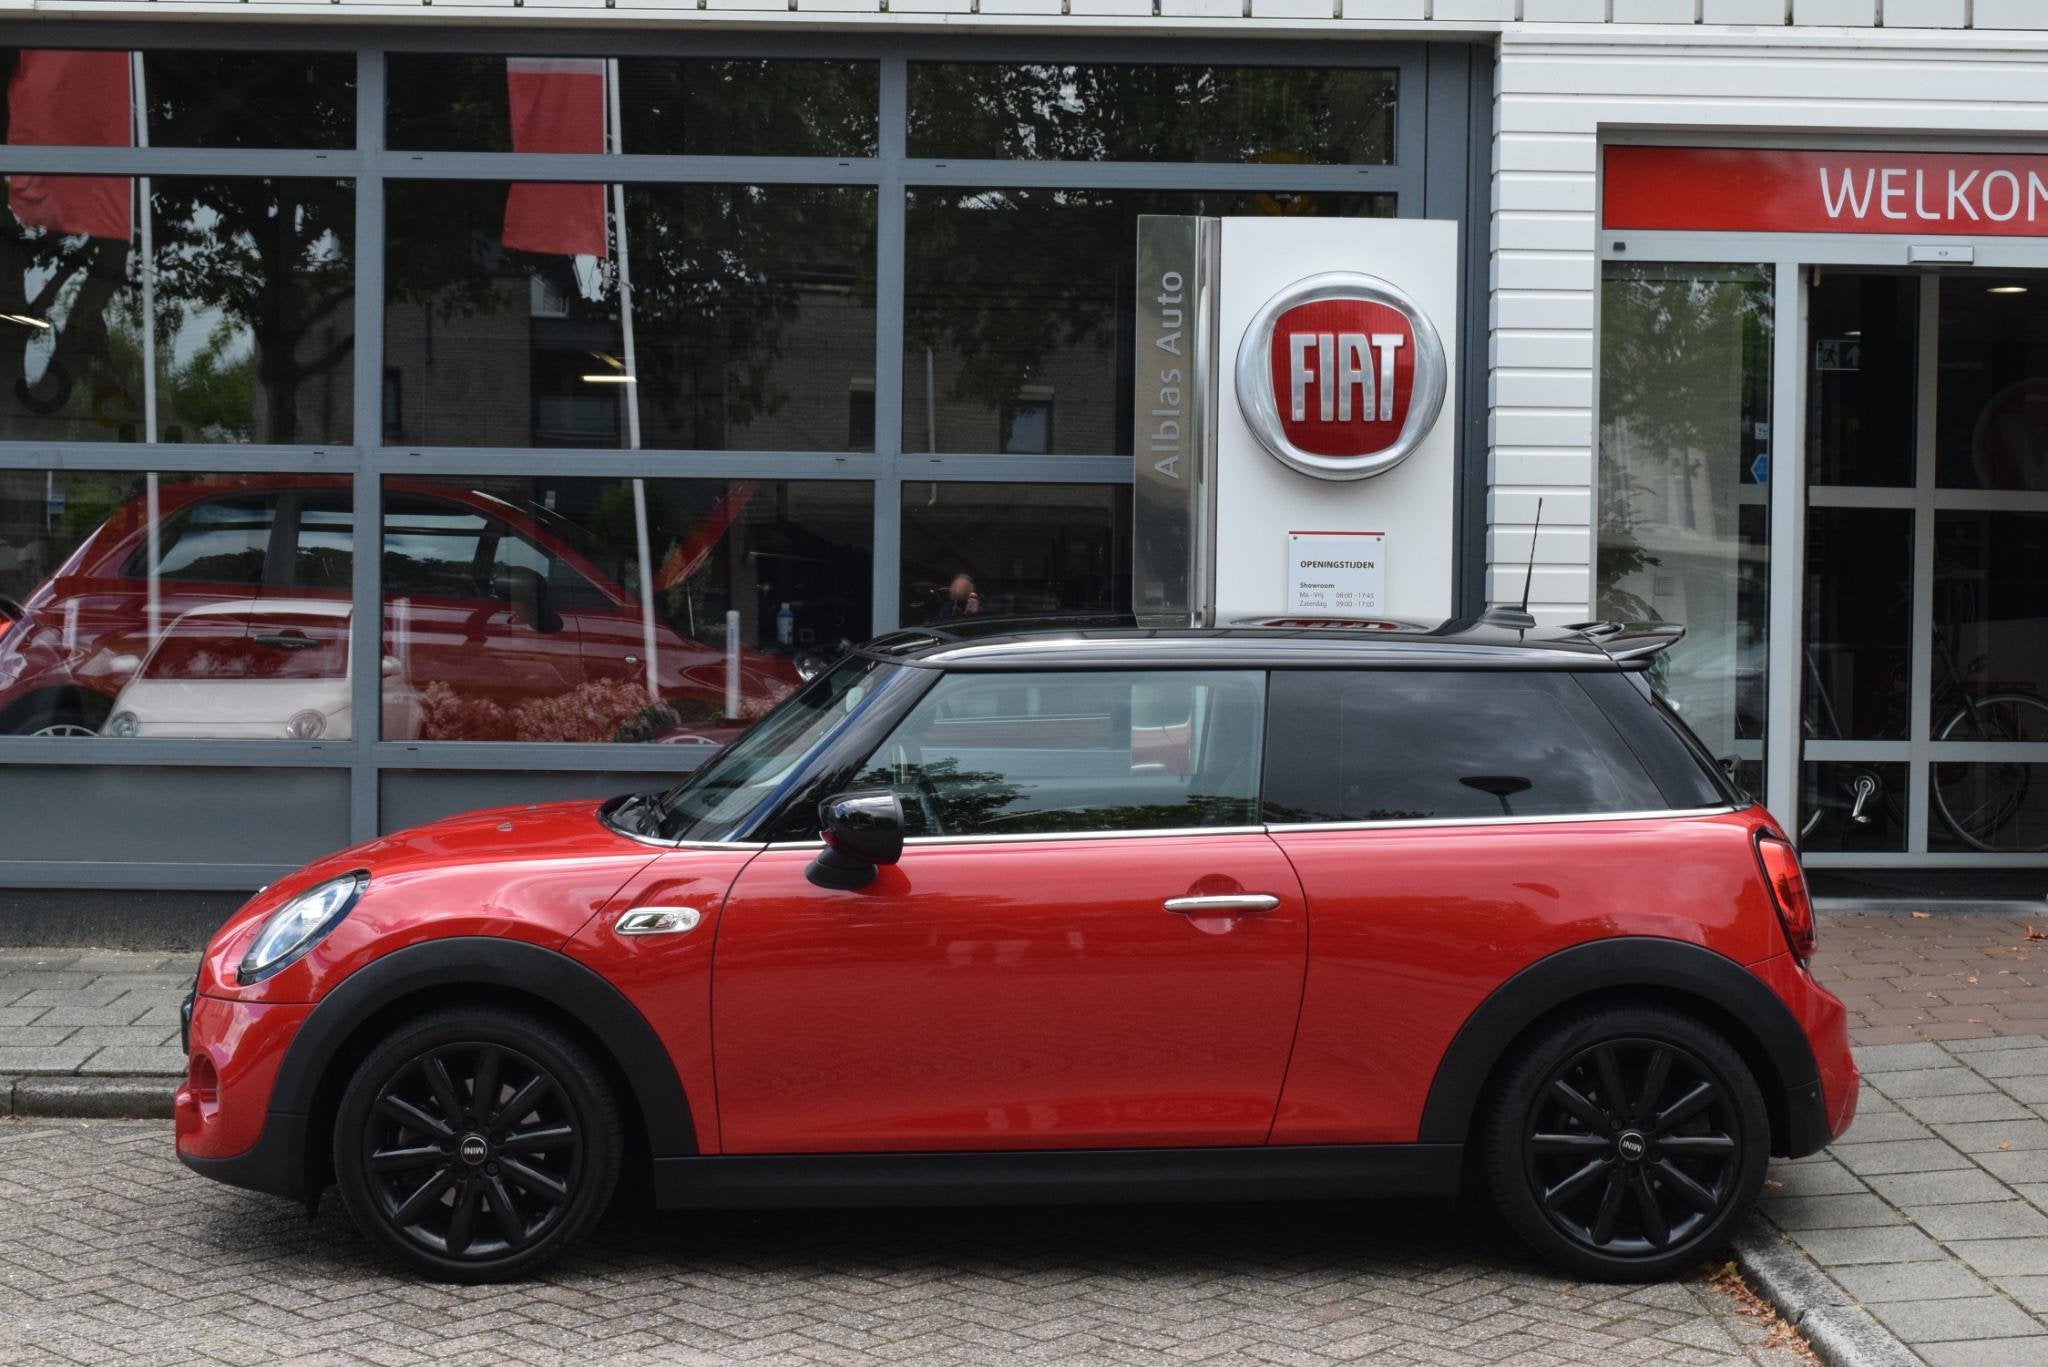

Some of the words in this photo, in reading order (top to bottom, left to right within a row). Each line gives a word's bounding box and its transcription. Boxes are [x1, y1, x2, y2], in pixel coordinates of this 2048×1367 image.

[1156, 271, 1183, 356] Auto
[1289, 333, 1404, 422] FIAT
[1151, 368, 1181, 479] Alblas
[1300, 560, 1375, 569] OPENINGSTIJDEN
[464, 1146, 484, 1155] MINI
[1622, 1140, 1641, 1152] MINI
